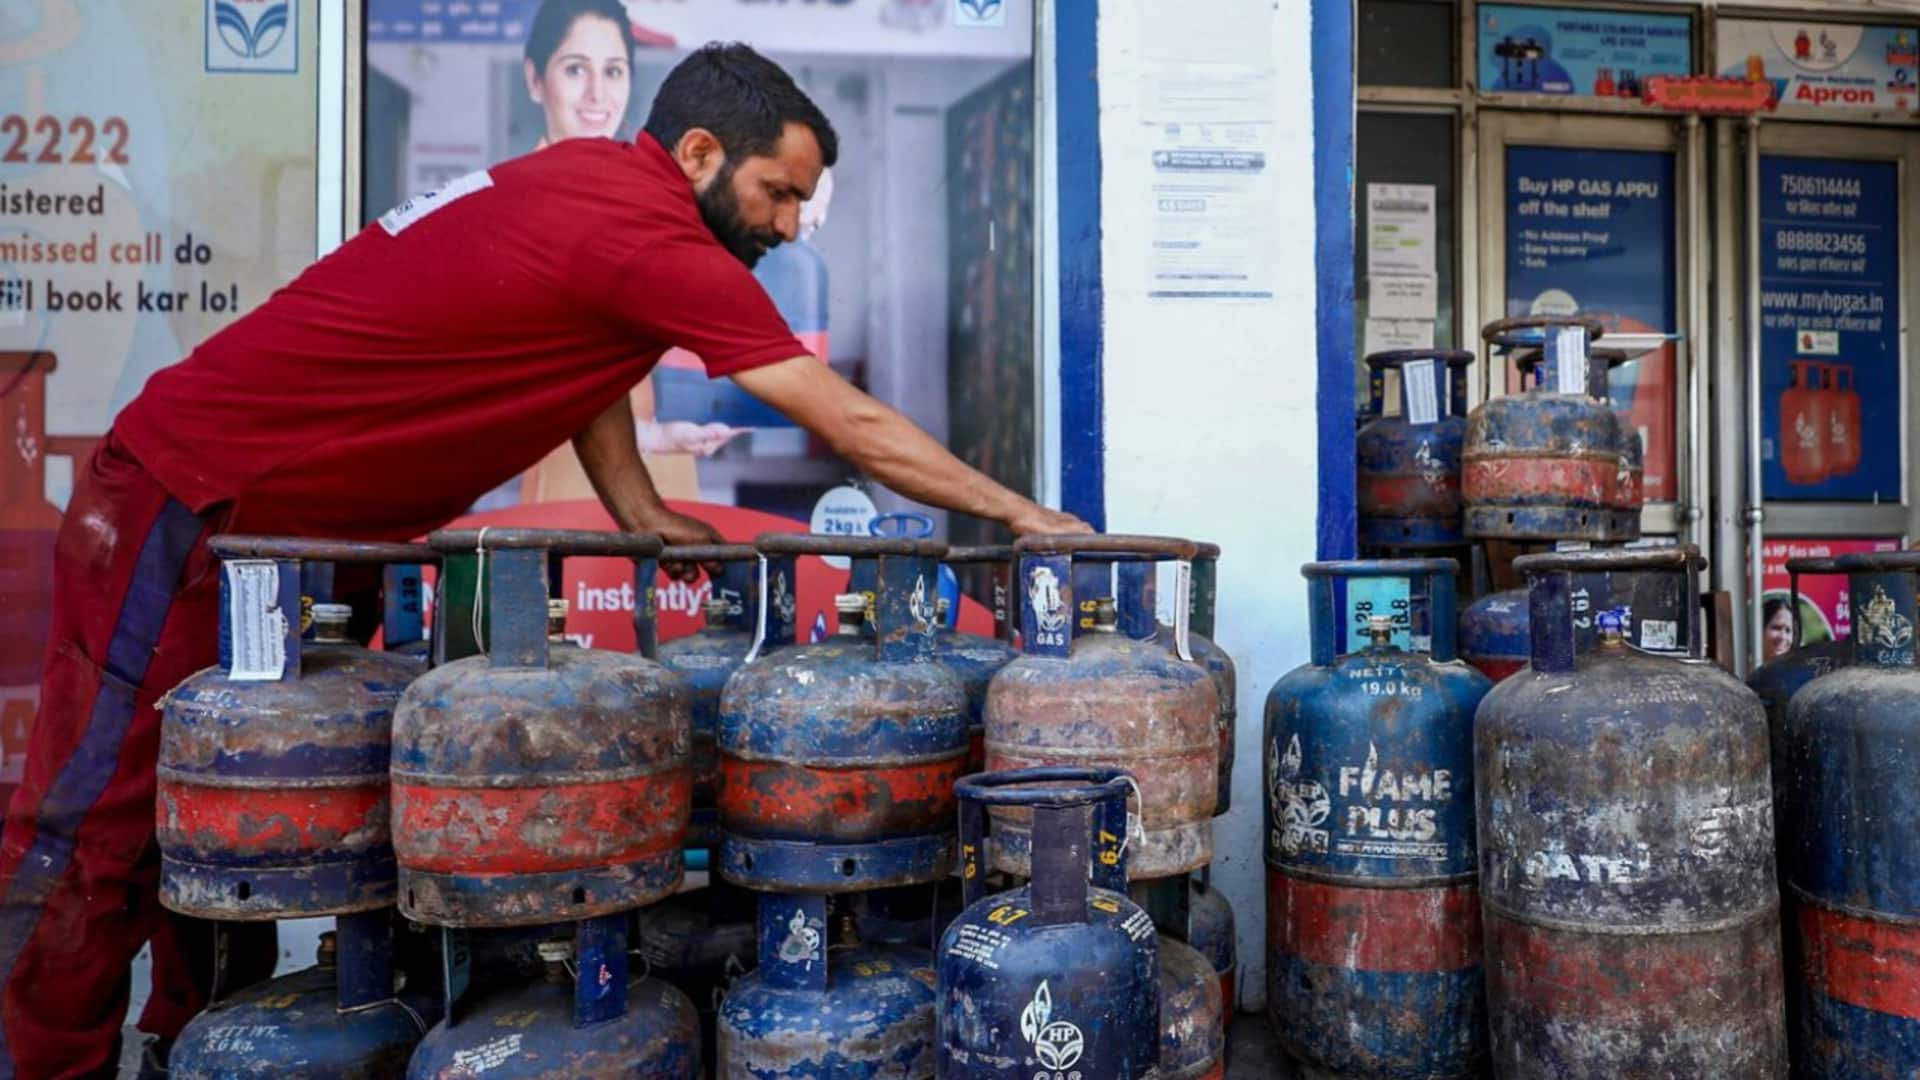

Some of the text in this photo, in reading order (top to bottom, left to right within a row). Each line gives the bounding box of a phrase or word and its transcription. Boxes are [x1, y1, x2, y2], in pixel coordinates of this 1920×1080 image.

[1796, 83, 1875, 106] Apron
[1518, 176, 1659, 197] Buy HP GAS APPU
[1781, 174, 1861, 197] 7506114444
[1, 185, 104, 215] istered
[1518, 200, 1611, 217] off the shelf
[1525, 230, 1538, 240] No
[1541, 231, 1580, 241] Address
[1777, 231, 1866, 253] 8888823456
[0, 233, 212, 263] missed call do
[1525, 244, 1588, 256] Easy to carry
[47, 280, 122, 312] book
[137, 281, 189, 312] kar
[201, 282, 238, 312] lo!
[1761, 291, 1884, 314] www.myhpgas.in
[577, 581, 713, 617] instntly?
[1036, 636, 1064, 647] GAS
[1350, 665, 1394, 678] NETT
[1361, 682, 1421, 697] 19.0 kg
[1347, 805, 1436, 841] PLUS
[1100, 831, 1120, 865] 6.7
[1049, 1027, 1074, 1041] HP
